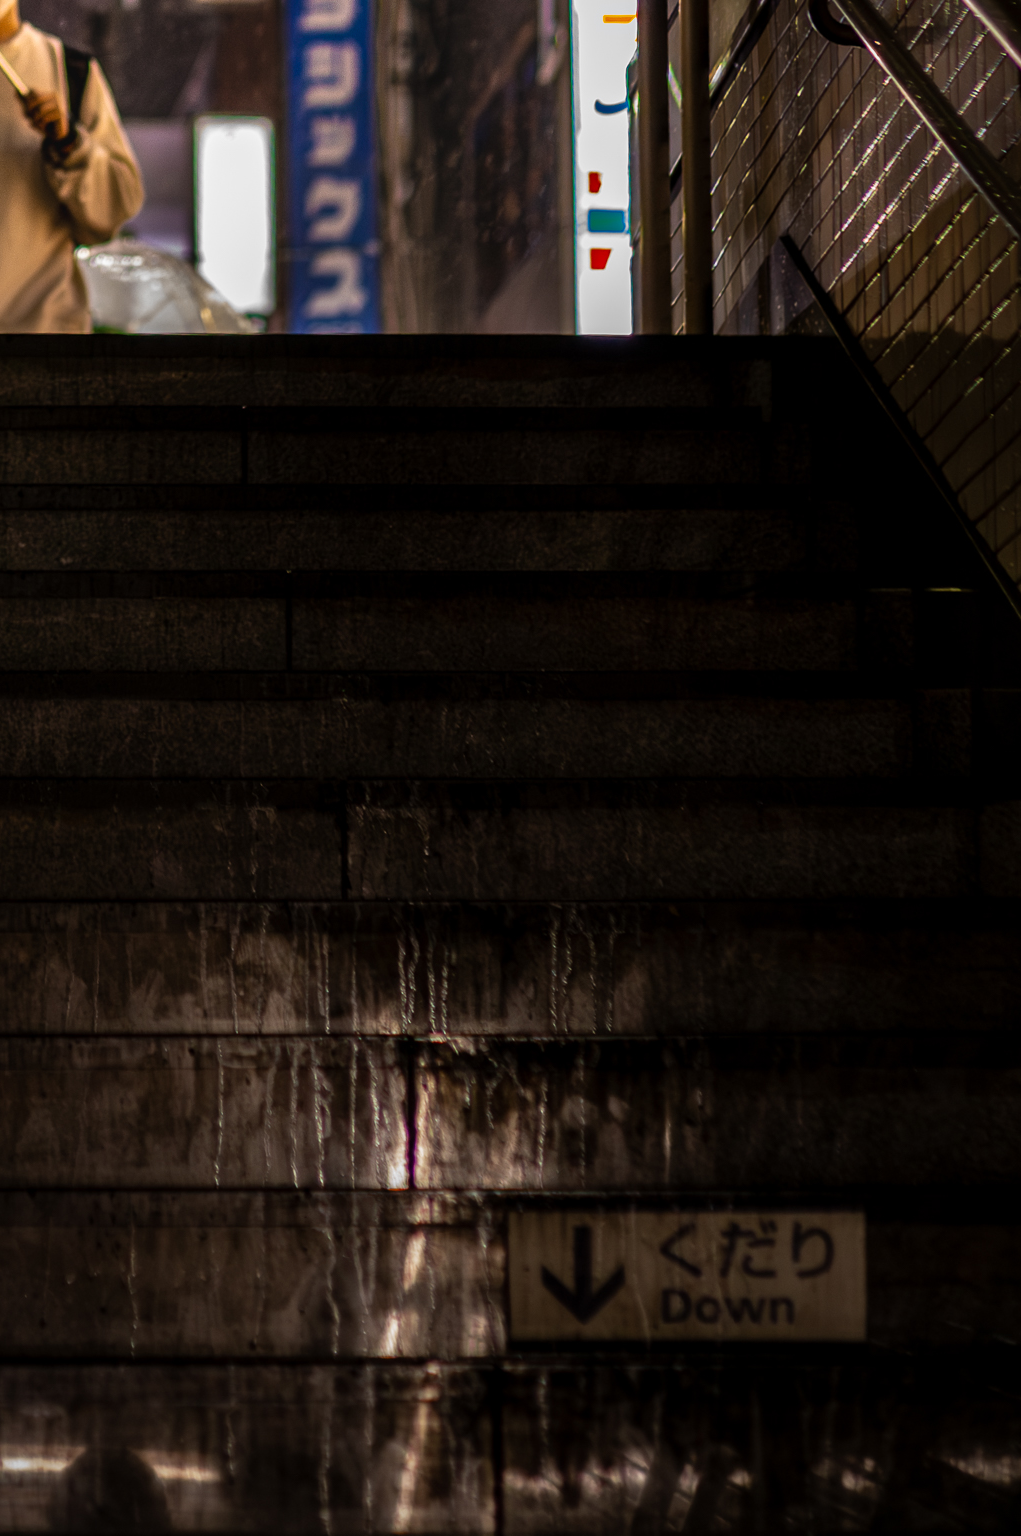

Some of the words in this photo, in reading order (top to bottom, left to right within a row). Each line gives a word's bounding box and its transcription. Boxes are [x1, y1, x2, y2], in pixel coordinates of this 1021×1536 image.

[660, 1221, 834, 1278] くだり
[661, 1287, 795, 1325] Down
